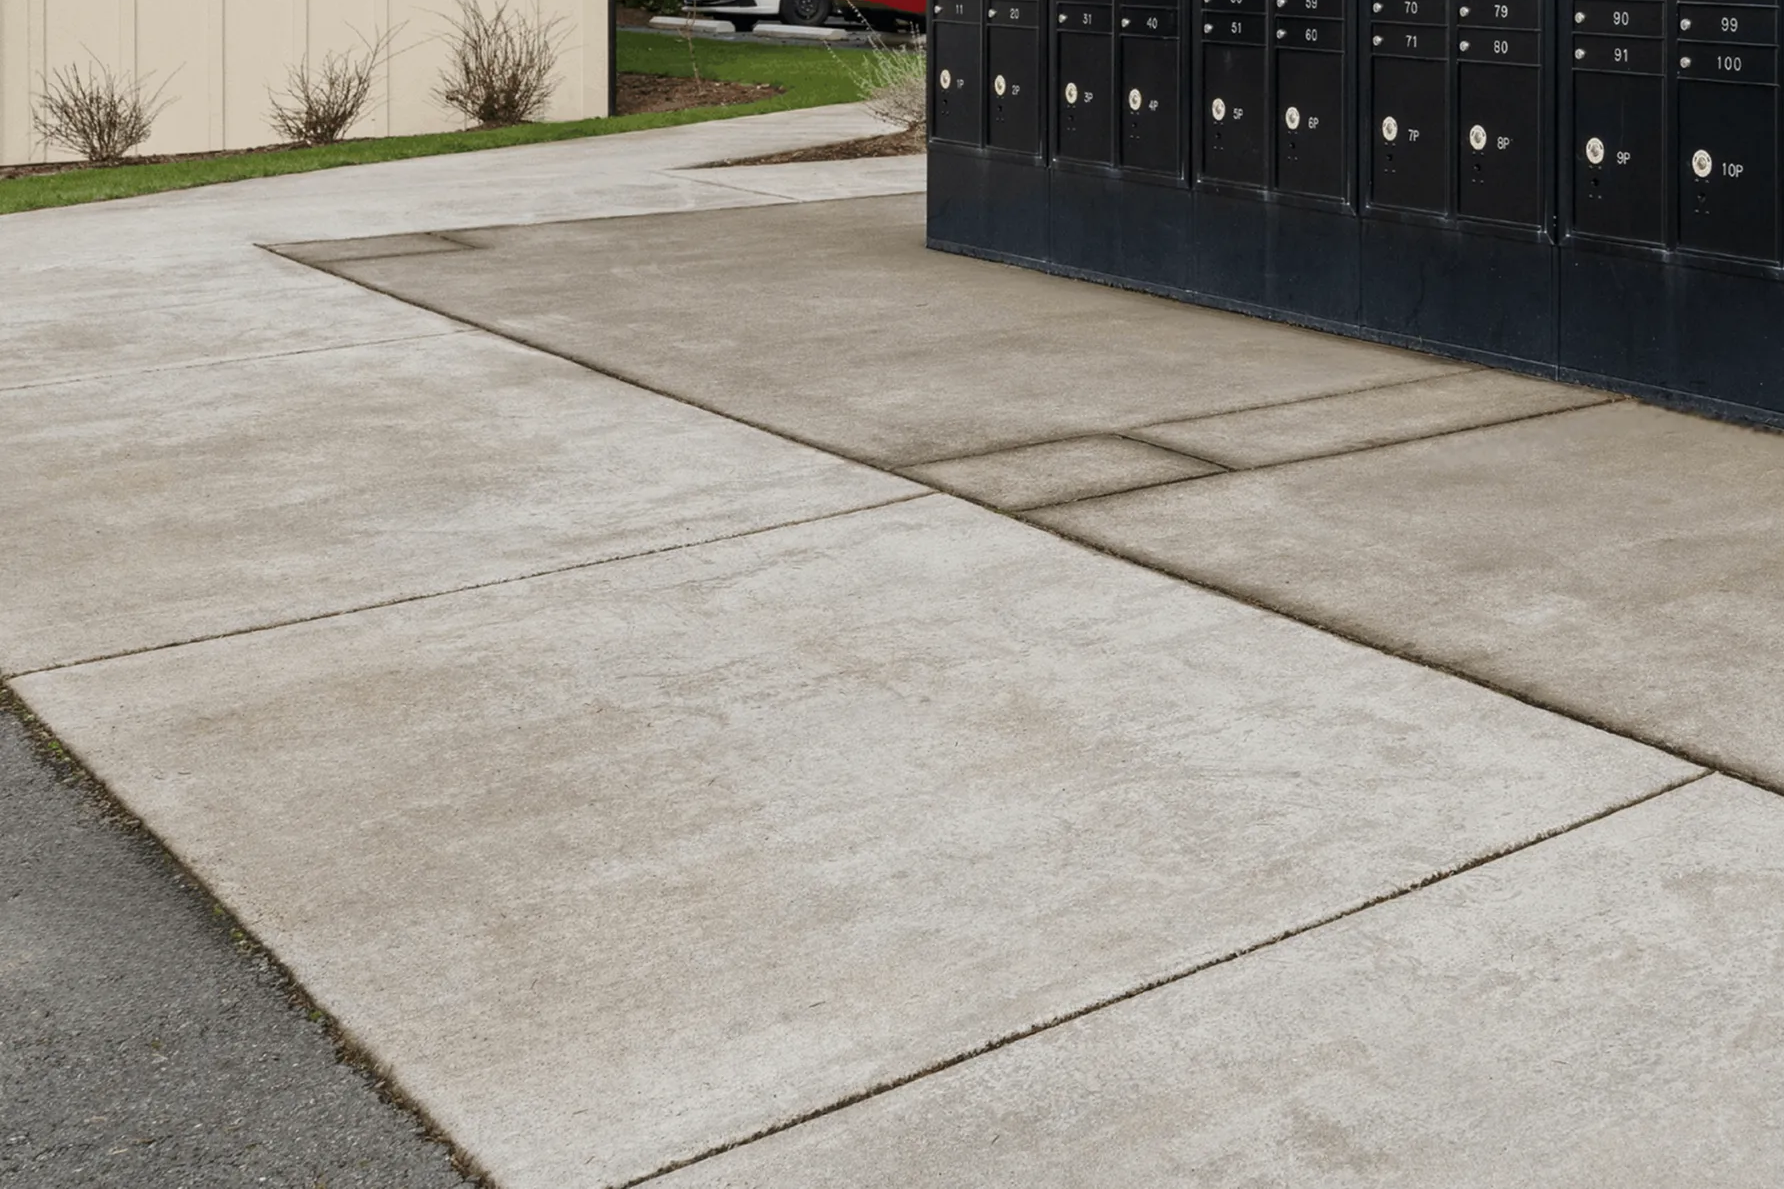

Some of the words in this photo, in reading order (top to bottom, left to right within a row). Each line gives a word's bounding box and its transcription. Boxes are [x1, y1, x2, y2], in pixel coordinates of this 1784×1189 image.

[1404, 0, 1418, 15] 70
[1494, 4, 1509, 19] 79
[1613, 11, 1630, 26] 90
[1721, 16, 1738, 33] 99
[1405, 34, 1417, 48] 71
[1493, 40, 1509, 54] 80
[1614, 47, 1628, 62] 91
[1717, 55, 1742, 72] 100
[1407, 128, 1420, 142] 7P
[1496, 136, 1510, 150] 8P
[1616, 150, 1631, 165] 9P
[1722, 162, 1744, 178] 10P
